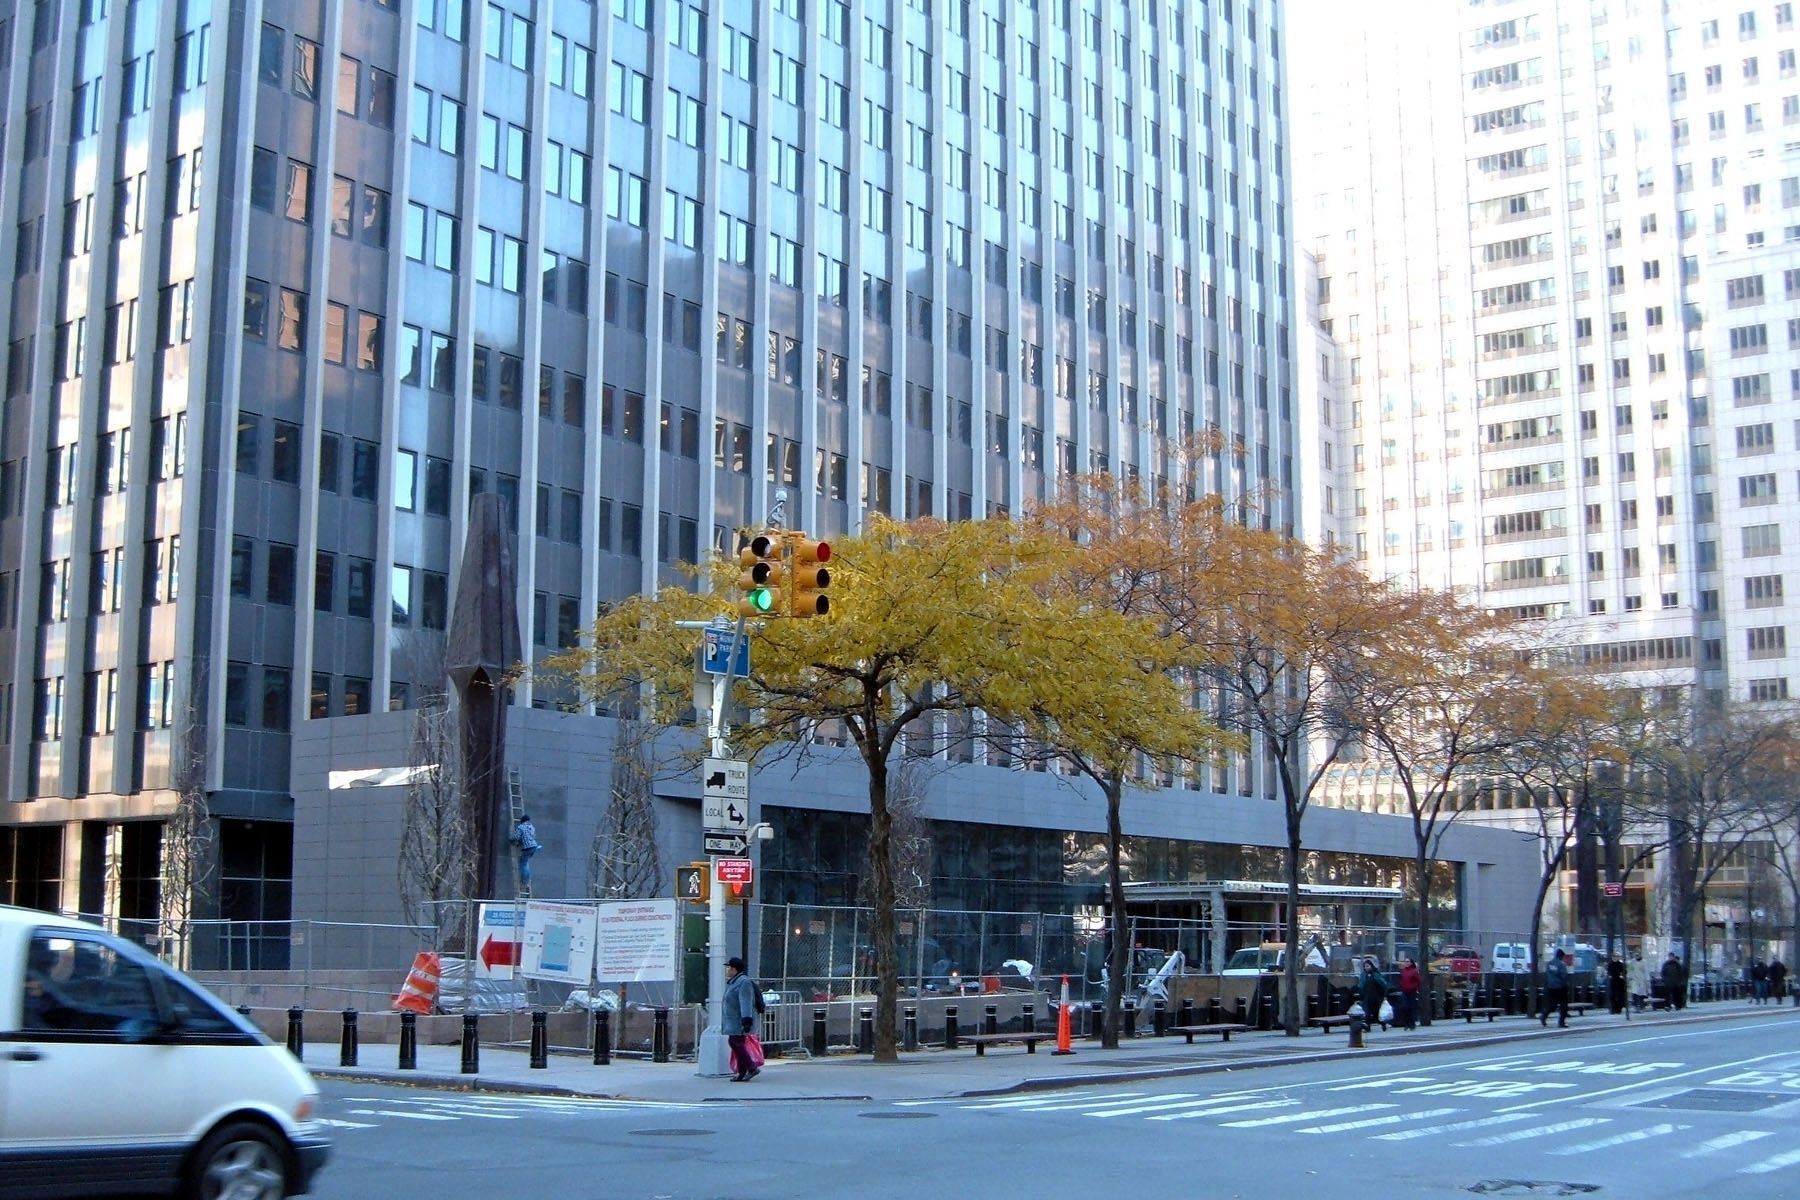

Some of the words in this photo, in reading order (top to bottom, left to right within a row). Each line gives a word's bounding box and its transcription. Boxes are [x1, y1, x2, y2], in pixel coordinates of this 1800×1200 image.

[707, 642, 717, 661] P
[728, 770, 745, 779] TRUCK
[728, 785, 745, 795] ROUTE
[705, 808, 724, 817] LOCAL
[709, 839, 722, 849] ONE
[729, 840, 742, 850] WAY
[1325, 1077, 1579, 1098] FIRE
